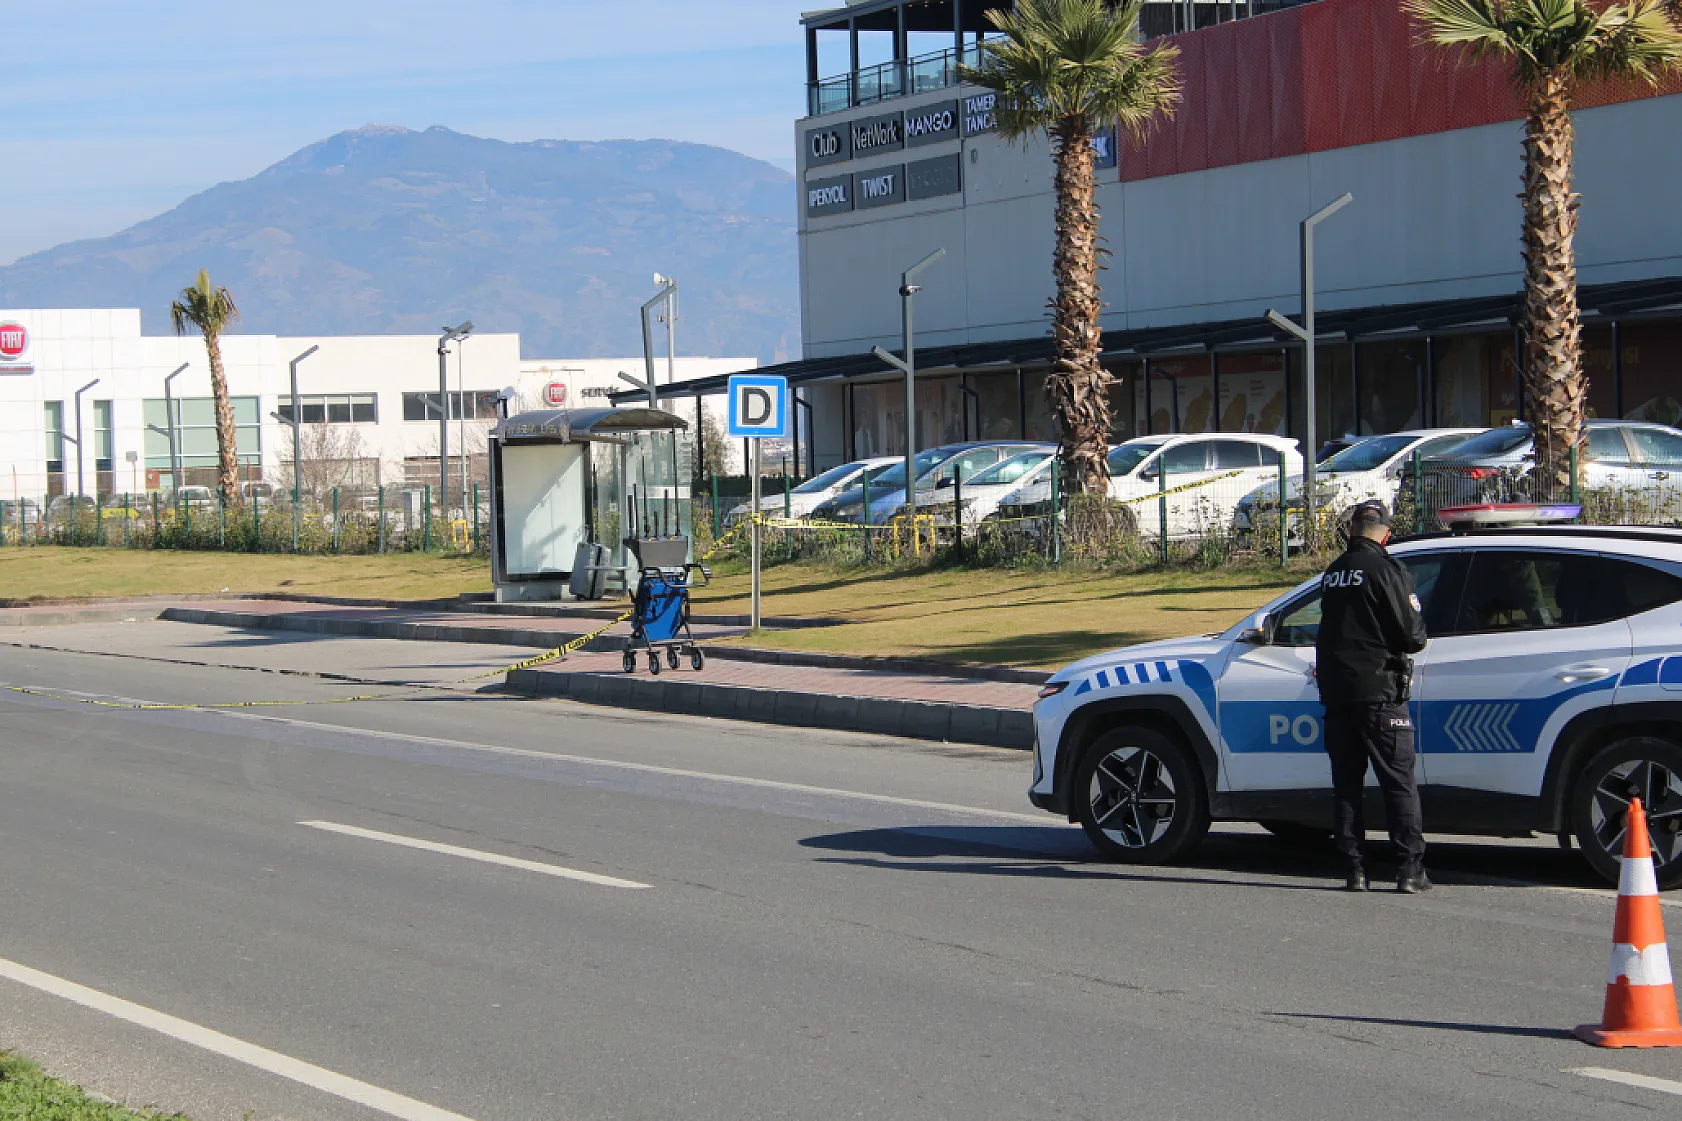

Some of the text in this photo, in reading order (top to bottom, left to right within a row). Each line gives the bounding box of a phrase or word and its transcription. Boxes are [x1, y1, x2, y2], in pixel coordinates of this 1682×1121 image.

[852, 119, 897, 151] NetWork
[905, 110, 952, 136] MANGO
[811, 130, 838, 158] Club
[861, 174, 894, 199] TWIST
[1, 331, 23, 349] FIAT
[741, 387, 771, 425] D
